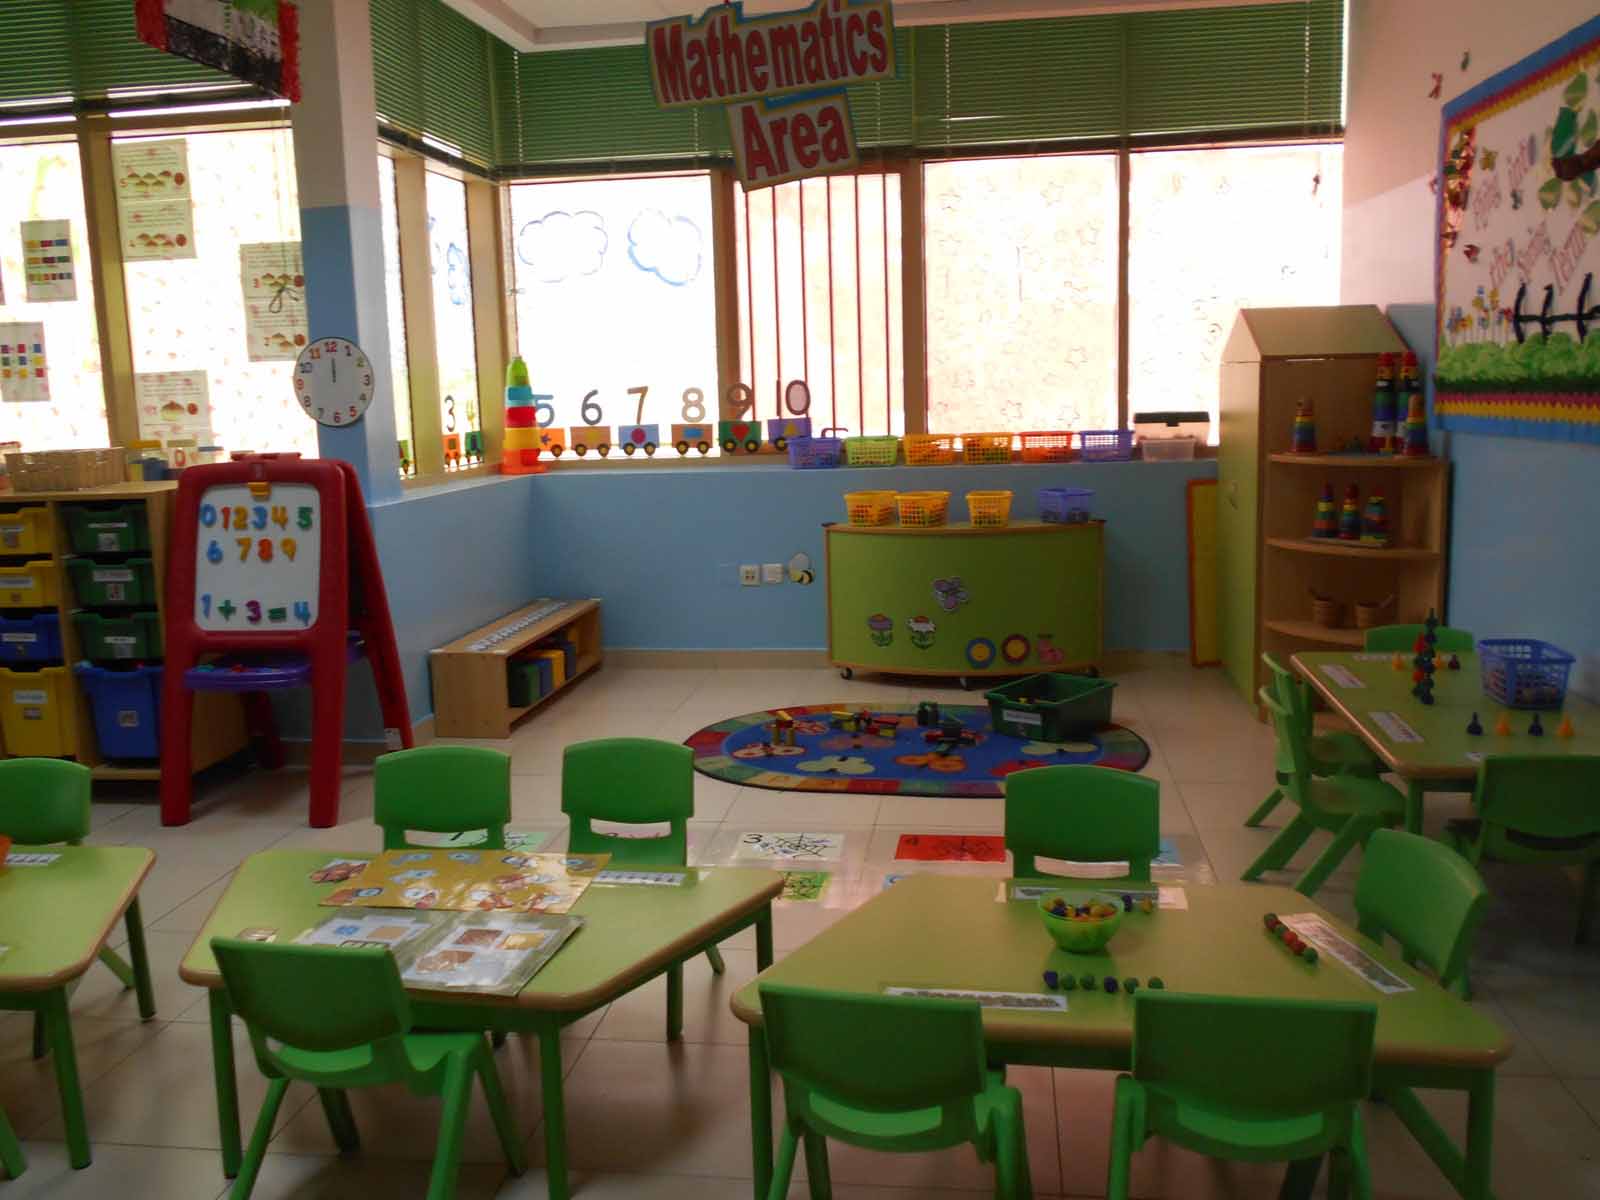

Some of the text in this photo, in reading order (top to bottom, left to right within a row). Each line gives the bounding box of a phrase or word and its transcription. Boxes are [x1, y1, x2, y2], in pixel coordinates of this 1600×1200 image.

[653, 1, 888, 104] Mathematics
[741, 105, 850, 181] Area
[309, 347, 321, 359] 11
[324, 341, 337, 352] 12
[444, 394, 457, 433] 3
[580, 389, 603, 426] 6
[626, 385, 649, 426] 7
[681, 387, 706, 423] 8
[727, 382, 753, 422] 9
[775, 379, 811, 418] 10
[207, 537, 297, 563] 6 7 8 9
[201, 594, 212, 619] 1
[246, 600, 262, 623] 3
[294, 601, 311, 627] 4
[743, 833, 763, 844] 3
